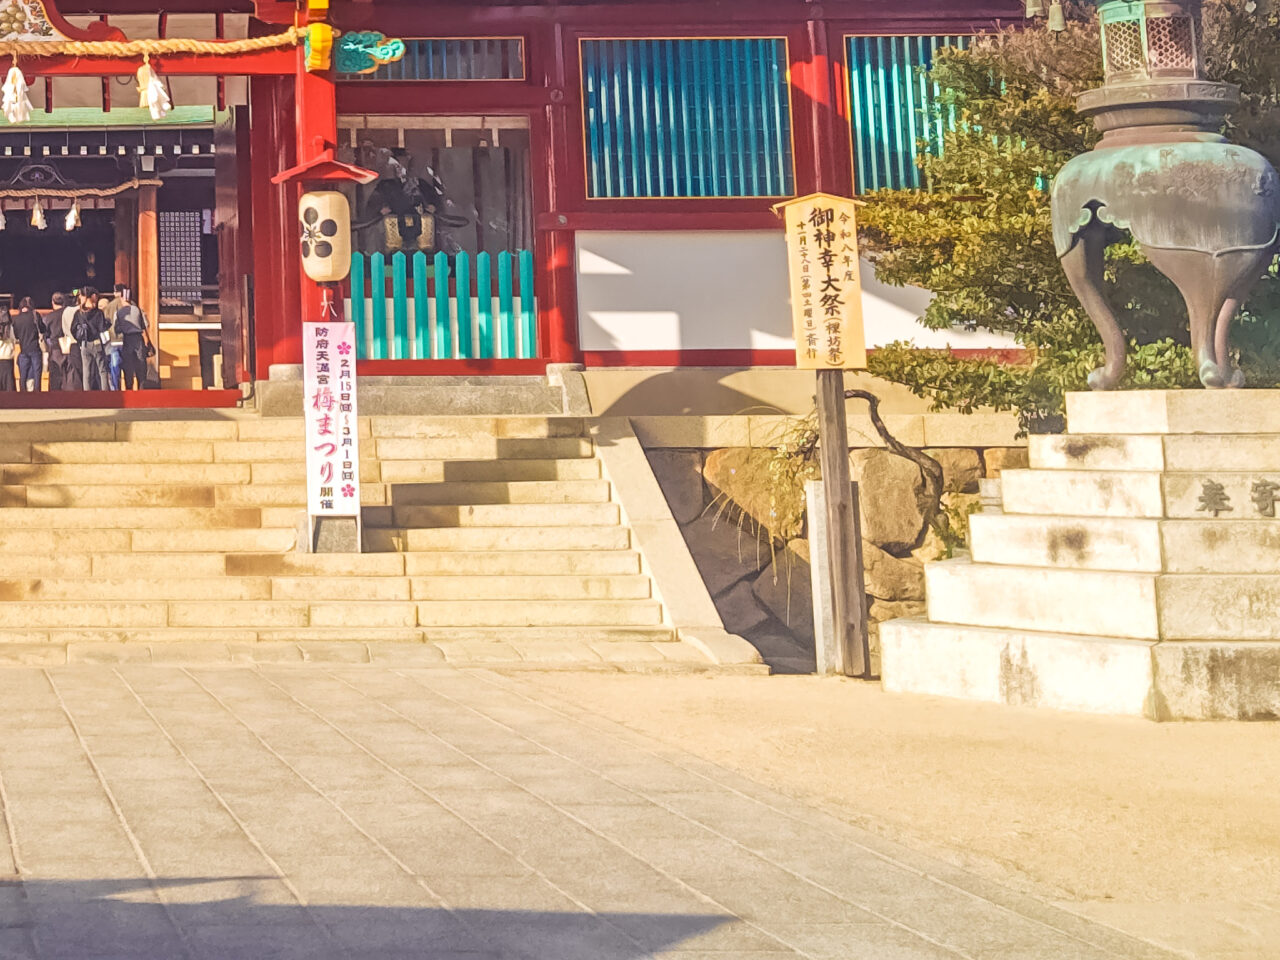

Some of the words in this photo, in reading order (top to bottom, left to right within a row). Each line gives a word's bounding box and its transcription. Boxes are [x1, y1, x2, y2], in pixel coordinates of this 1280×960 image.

[839, 211, 855, 282] 令和八年度
